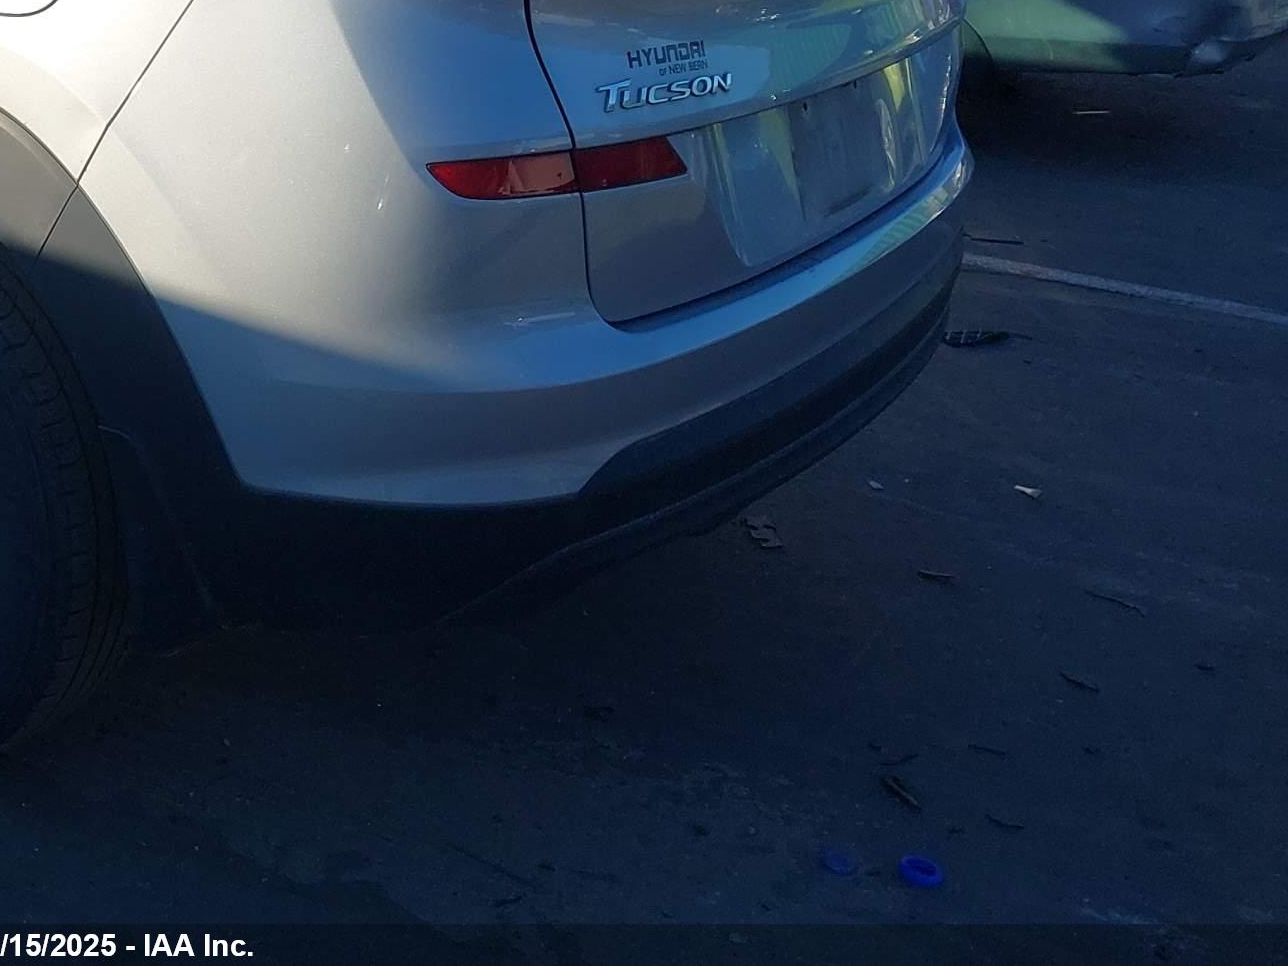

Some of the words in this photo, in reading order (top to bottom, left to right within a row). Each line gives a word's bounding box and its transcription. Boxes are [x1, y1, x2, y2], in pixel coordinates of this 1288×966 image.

[627, 40, 706, 68] HYUNDAI
[668, 63, 687, 75] NEW
[597, 72, 732, 113] TUCSON
